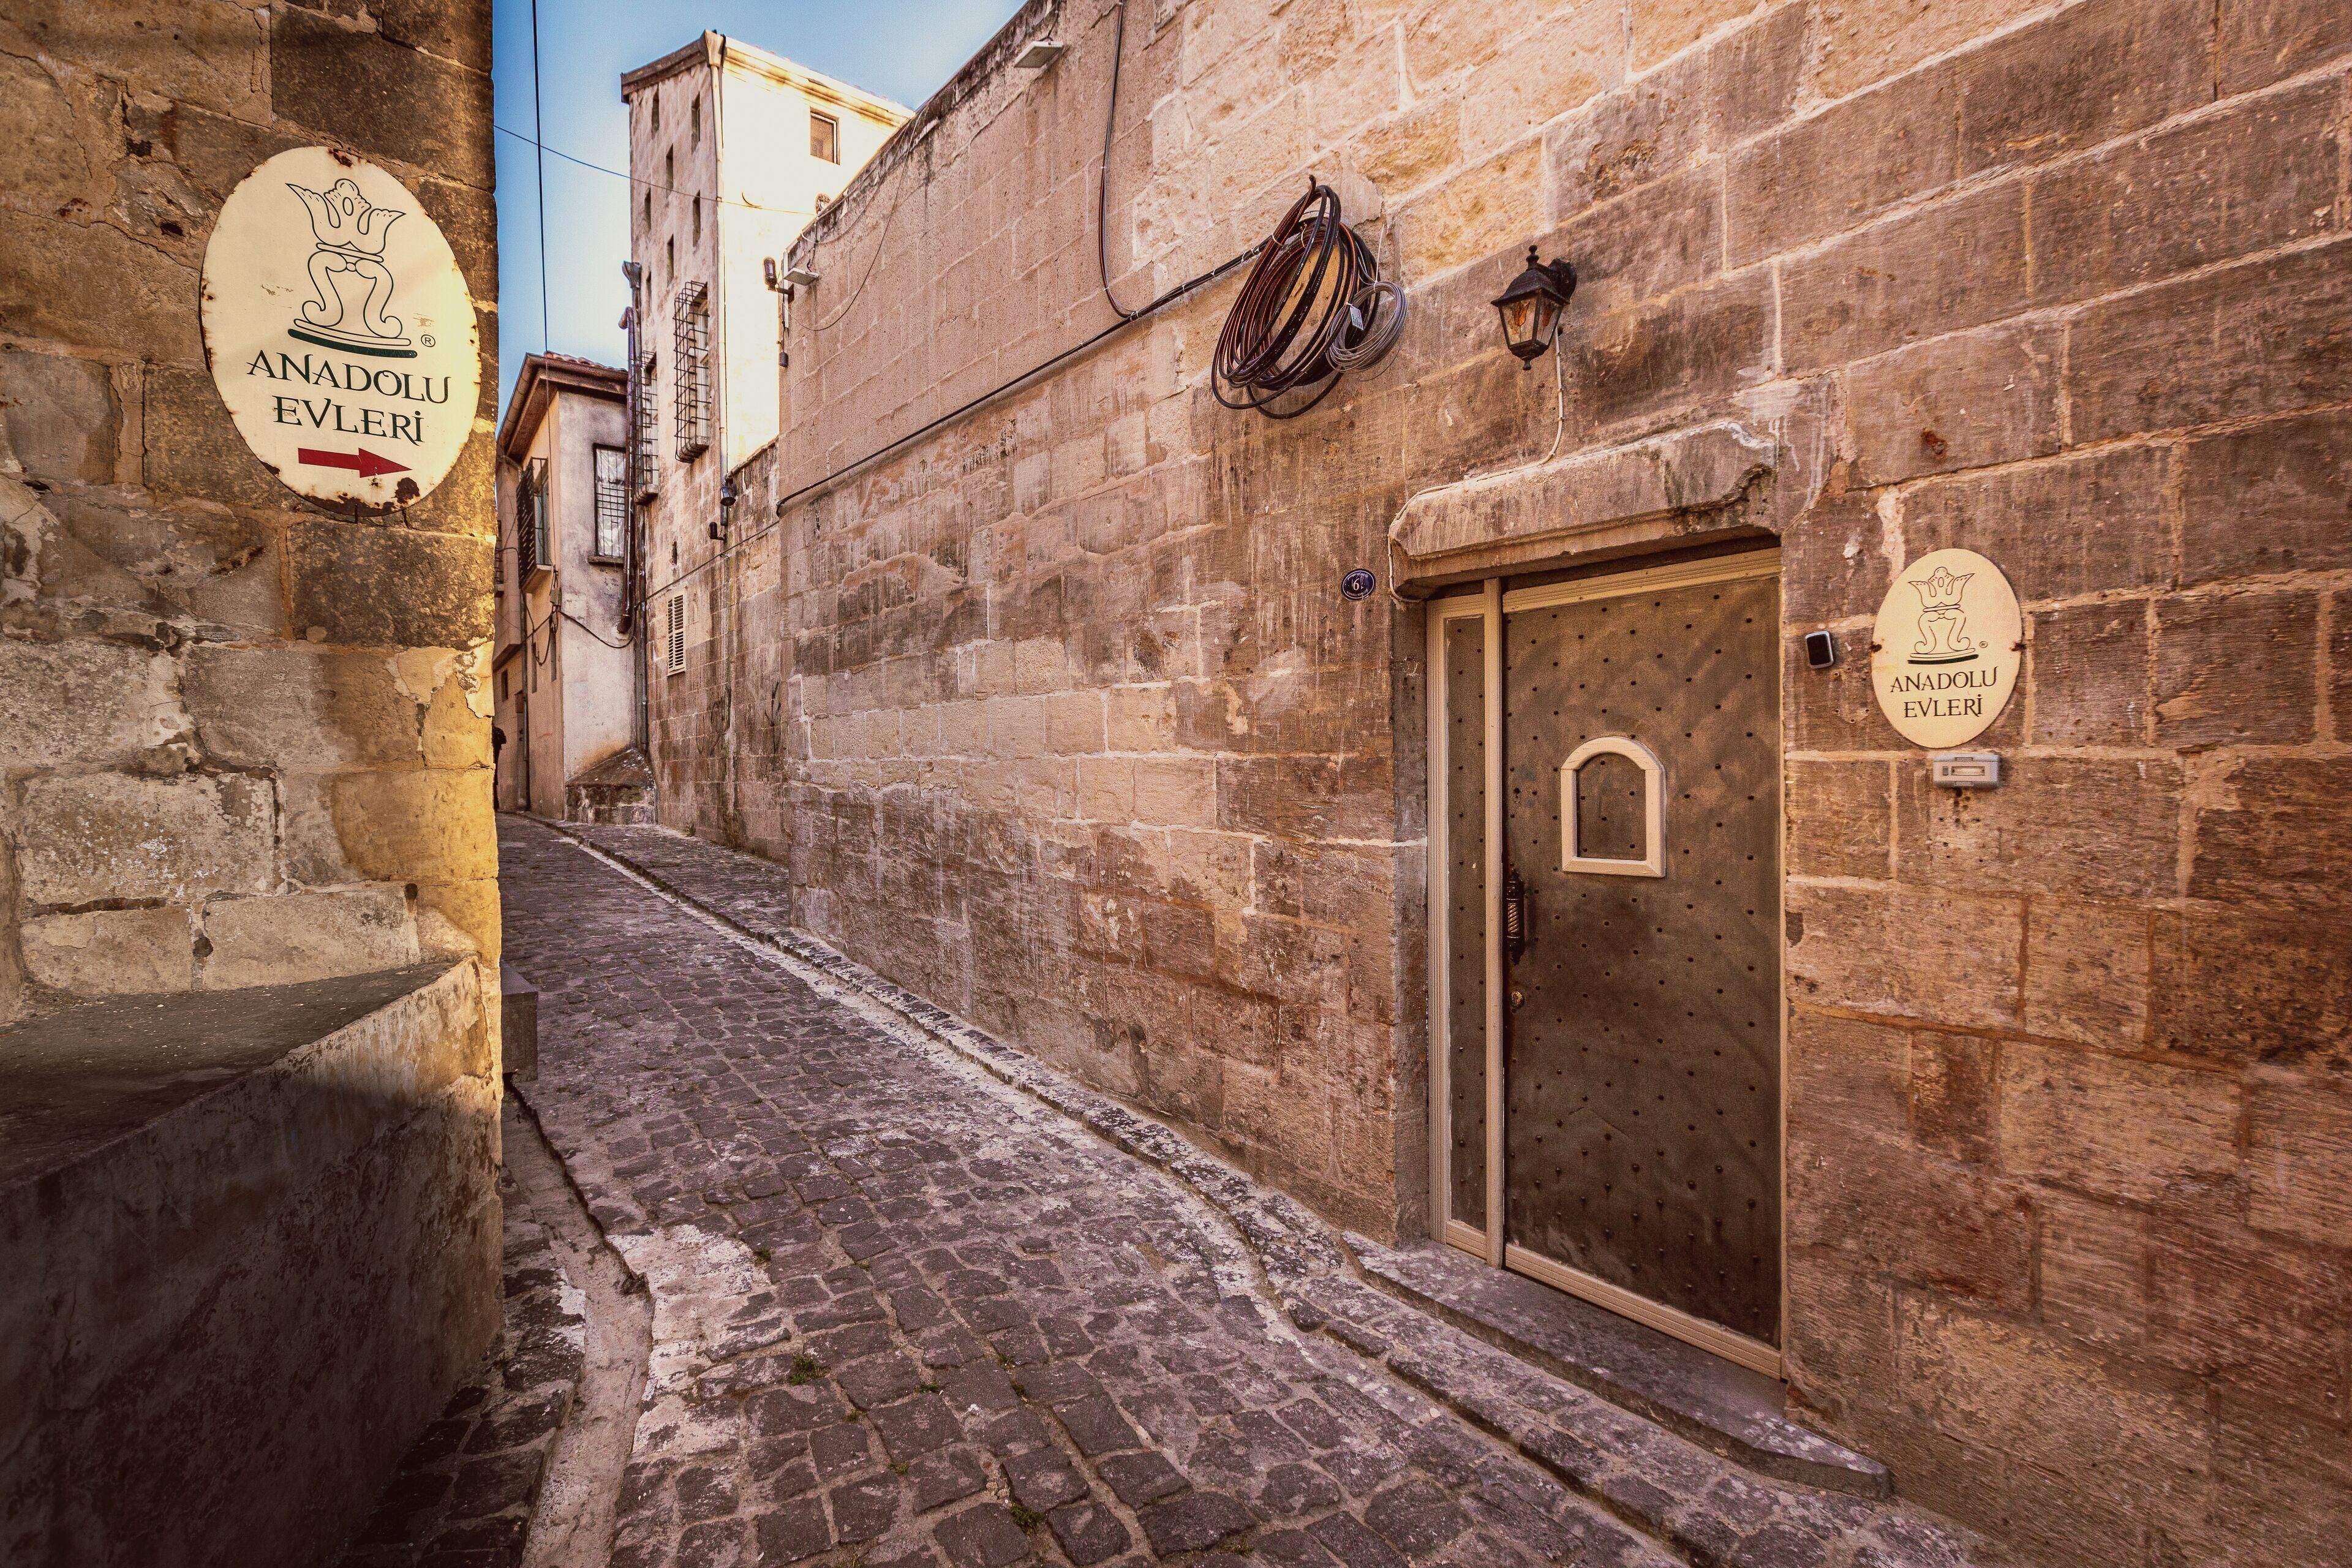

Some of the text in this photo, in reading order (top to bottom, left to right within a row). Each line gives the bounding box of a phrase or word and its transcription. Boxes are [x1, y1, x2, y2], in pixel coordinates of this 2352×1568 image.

[246, 349, 451, 404] ANADOLU
[271, 395, 425, 447] EVLERİ
[1890, 666, 1999, 693] ANADOLU
[1904, 694, 1984, 718] EVLERİ
